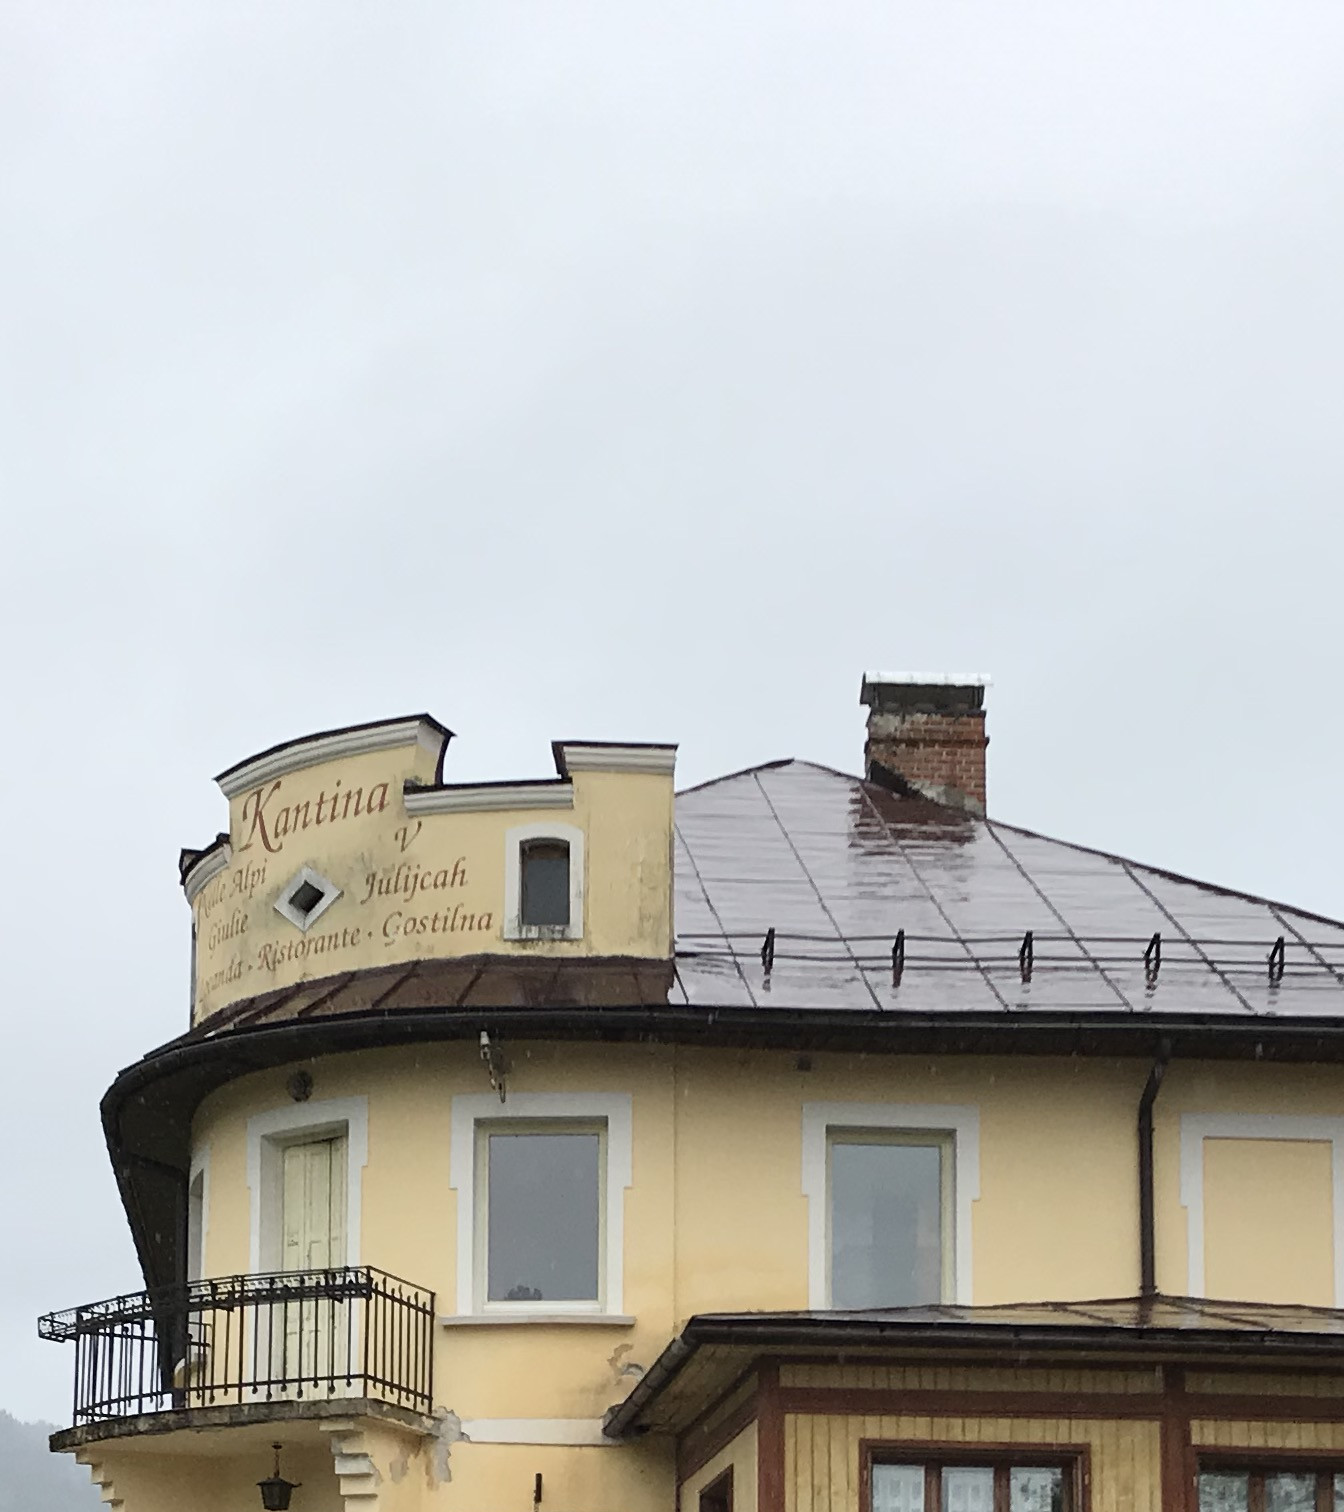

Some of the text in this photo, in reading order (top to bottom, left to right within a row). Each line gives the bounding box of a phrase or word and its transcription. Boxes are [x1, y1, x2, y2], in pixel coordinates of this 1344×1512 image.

[238, 779, 390, 853] Kantina
[229, 858, 268, 900] Alpi
[360, 856, 468, 905] Julijcah
[208, 907, 249, 959] Giulie
[256, 926, 361, 974] Ristorante
[382, 902, 493, 948] Gostilna
